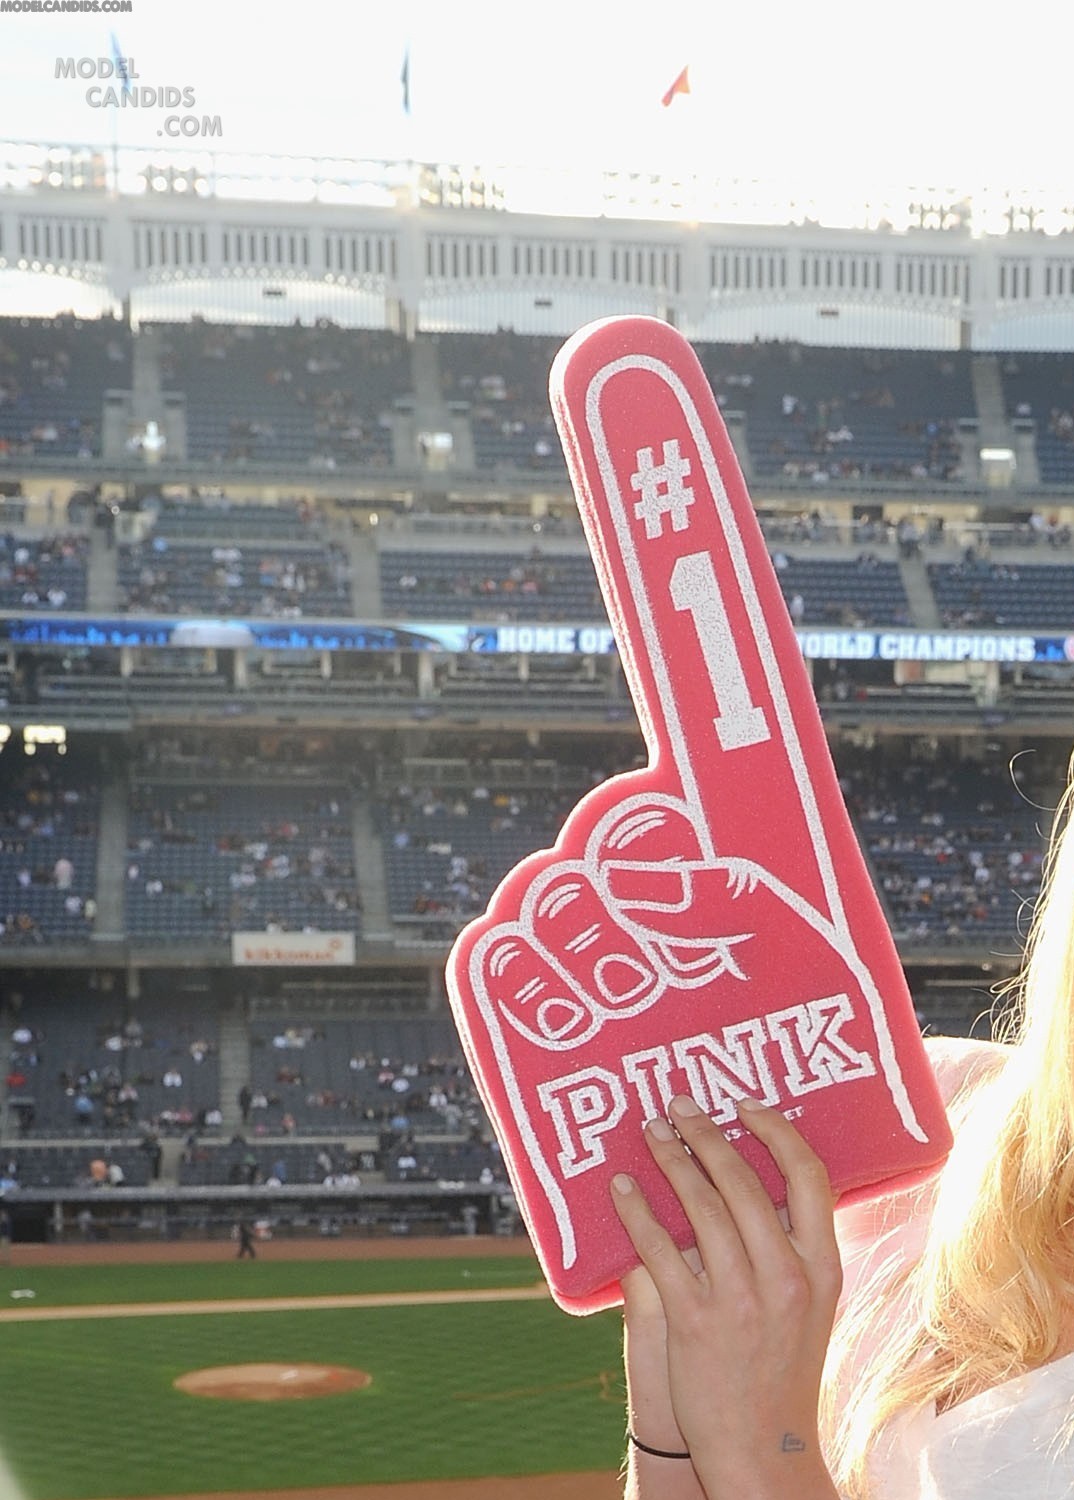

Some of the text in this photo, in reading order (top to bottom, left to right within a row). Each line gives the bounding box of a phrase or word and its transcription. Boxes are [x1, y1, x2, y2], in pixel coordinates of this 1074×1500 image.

[499, 626, 615, 653] HOME OF
[669, 550, 771, 751] 1
[878, 634, 1037, 661] CHAMPIONS
[536, 993, 877, 1180] PINK
